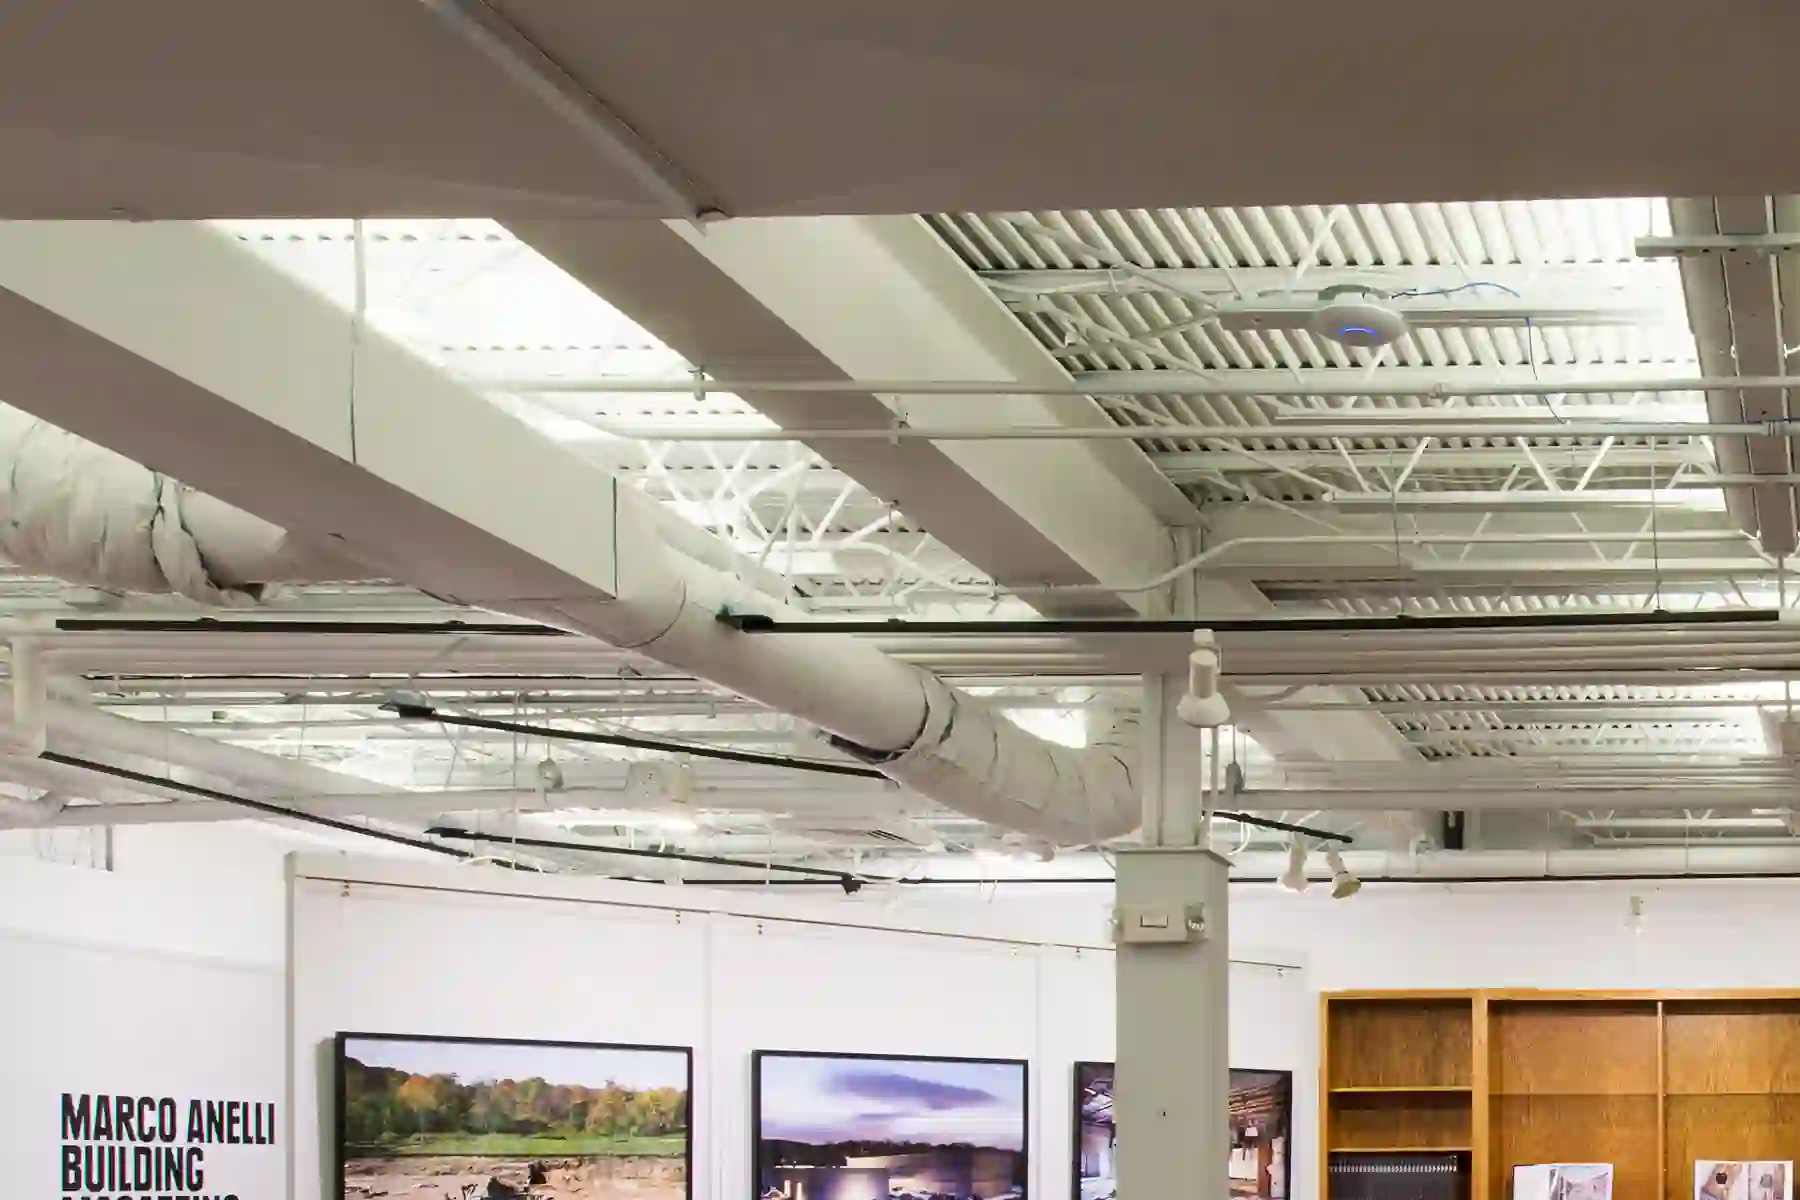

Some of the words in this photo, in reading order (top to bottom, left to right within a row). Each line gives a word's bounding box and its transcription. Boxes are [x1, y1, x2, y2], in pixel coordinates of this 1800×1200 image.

[61, 1093, 176, 1142] MARCO
[187, 1099, 275, 1144] ANELLI
[61, 1145, 204, 1192] BUILDING
